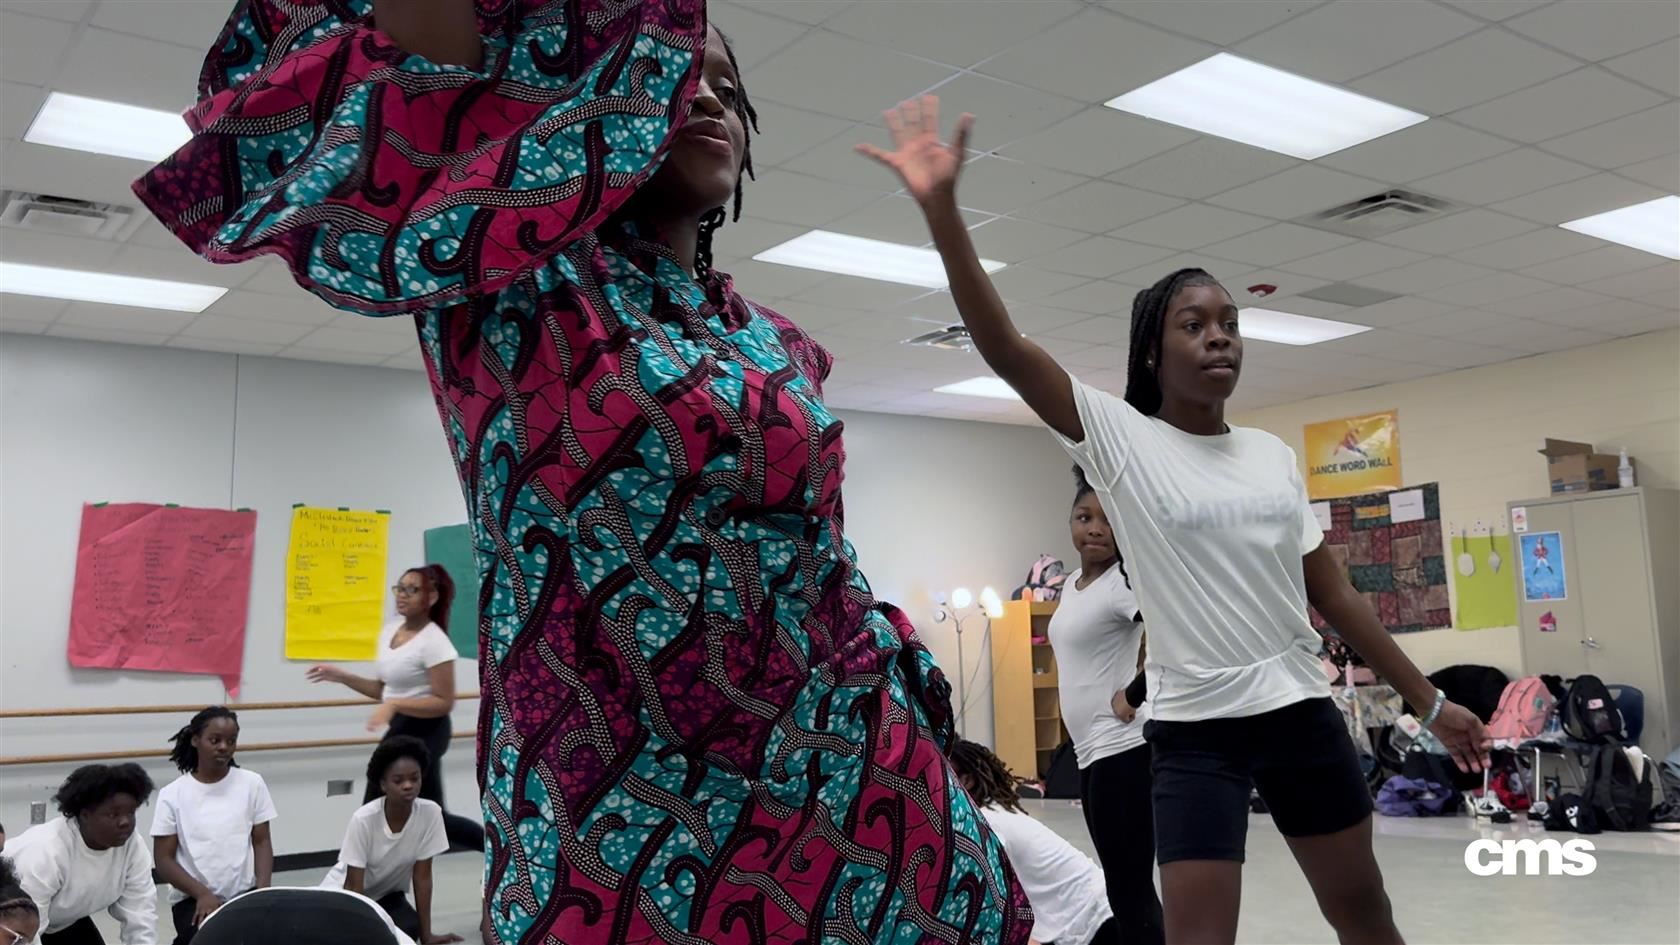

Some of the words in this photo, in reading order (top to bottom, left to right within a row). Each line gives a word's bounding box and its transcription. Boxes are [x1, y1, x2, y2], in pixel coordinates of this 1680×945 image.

[1310, 463, 1339, 476] DANCE
[1340, 459, 1366, 472] WORD
[1368, 456, 1393, 468] WALL
